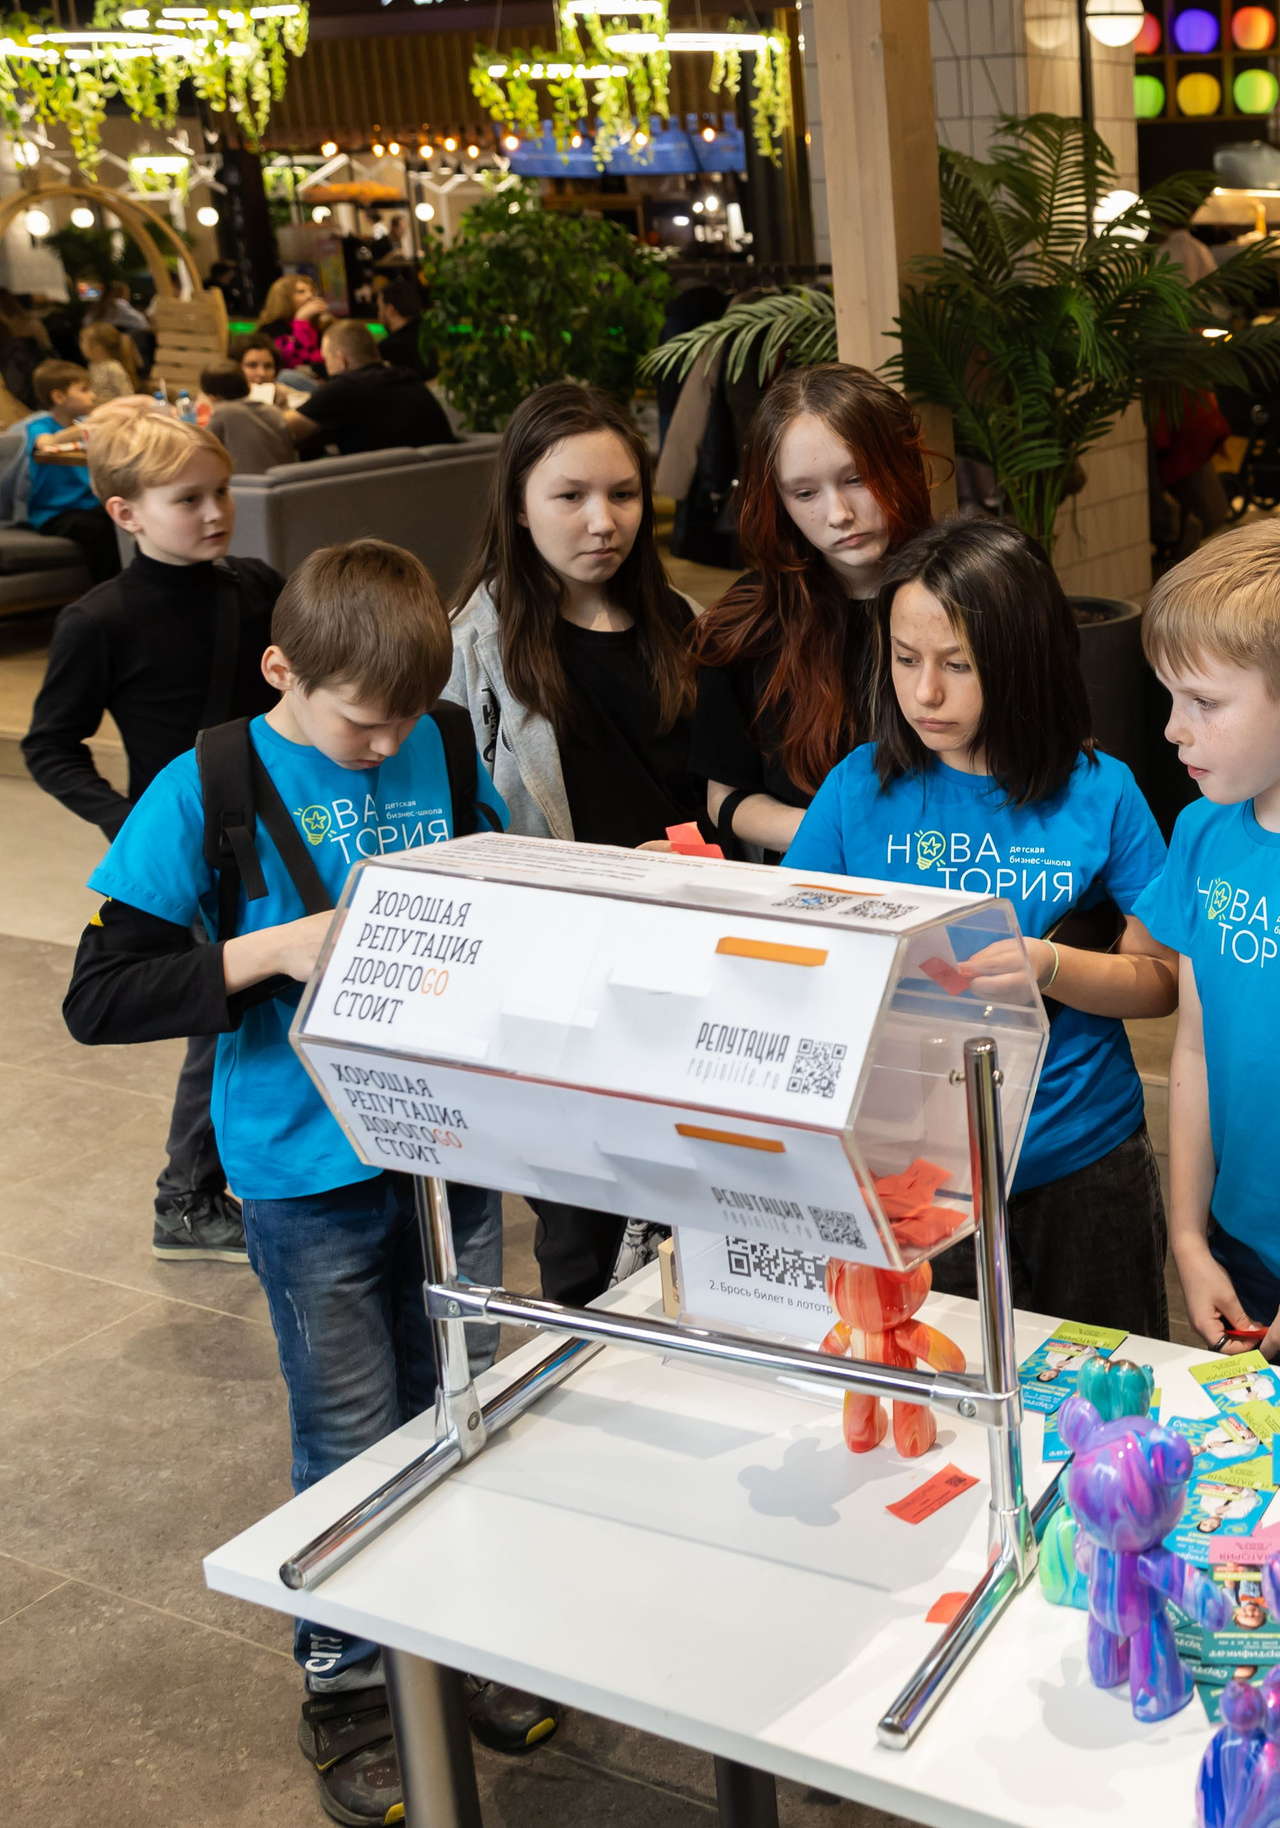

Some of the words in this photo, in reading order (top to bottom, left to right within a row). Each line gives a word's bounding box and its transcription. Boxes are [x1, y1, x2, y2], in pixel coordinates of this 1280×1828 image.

[384, 800, 417, 811] детская
[385, 807, 443, 820] бизнес-школа
[1009, 845, 1045, 854] детская
[1009, 856, 1072, 867] бизнес-школа
[936, 867, 1073, 903] ТОРИЯ
[369, 889, 472, 927] ХОРОШАЯ
[356, 922, 483, 965] РЕПУТАЦИЯ
[333, 990, 404, 1024] СТОИТ
[695, 1021, 791, 1064] РЕПУТАЦИЯ
[330, 1062, 434, 1098] ХОРОШАЯ
[343, 1087, 469, 1129] РЕПУТАЦИЯ
[374, 1136, 441, 1165] СТОИТ
[711, 1186, 805, 1221] РЕПУТАЦИЯ
[709, 1280, 719, 1291] 2.
[720, 1283, 752, 1298] Брось
[753, 1290, 784, 1305] билет
[787, 1297, 794, 1306] в
